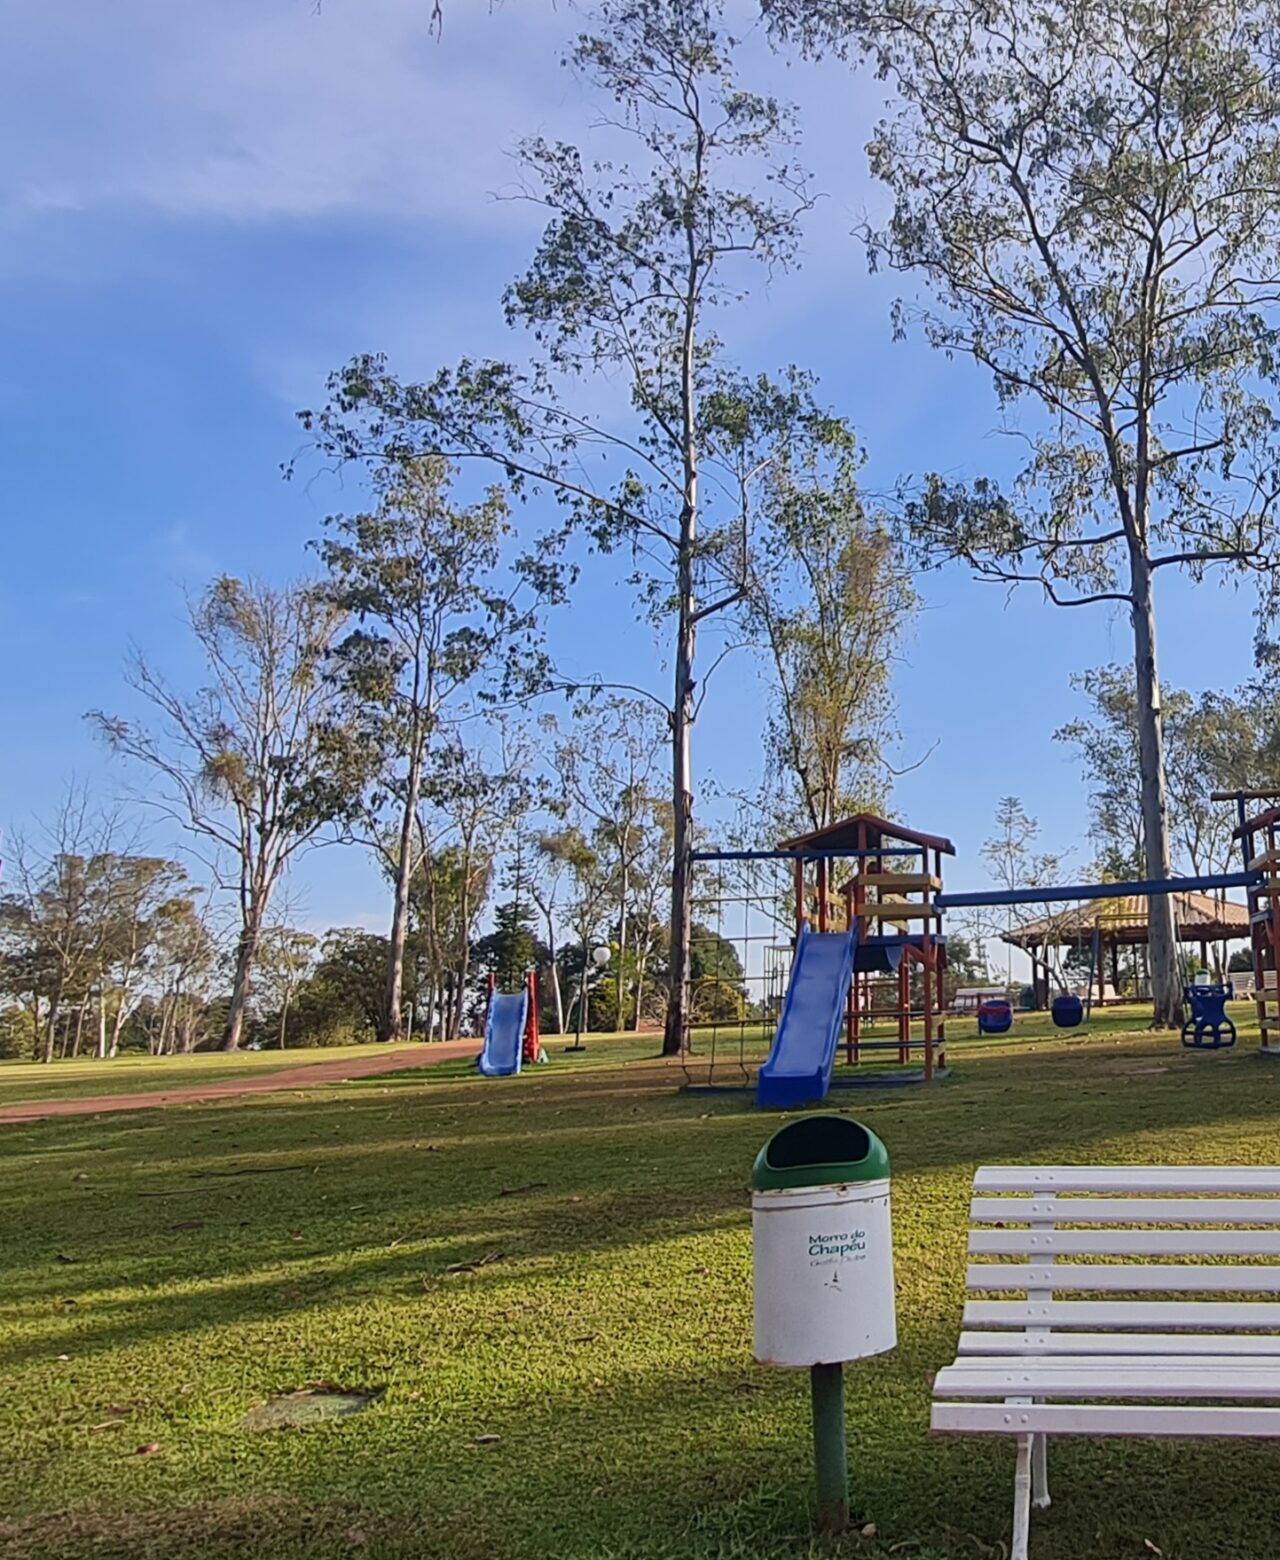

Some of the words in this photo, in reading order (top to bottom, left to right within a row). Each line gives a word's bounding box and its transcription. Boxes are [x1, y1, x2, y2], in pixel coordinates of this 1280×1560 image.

[809, 1233, 848, 1244] Morro
[850, 1229, 865, 1240] do
[809, 1239, 866, 1256] Chapéu
